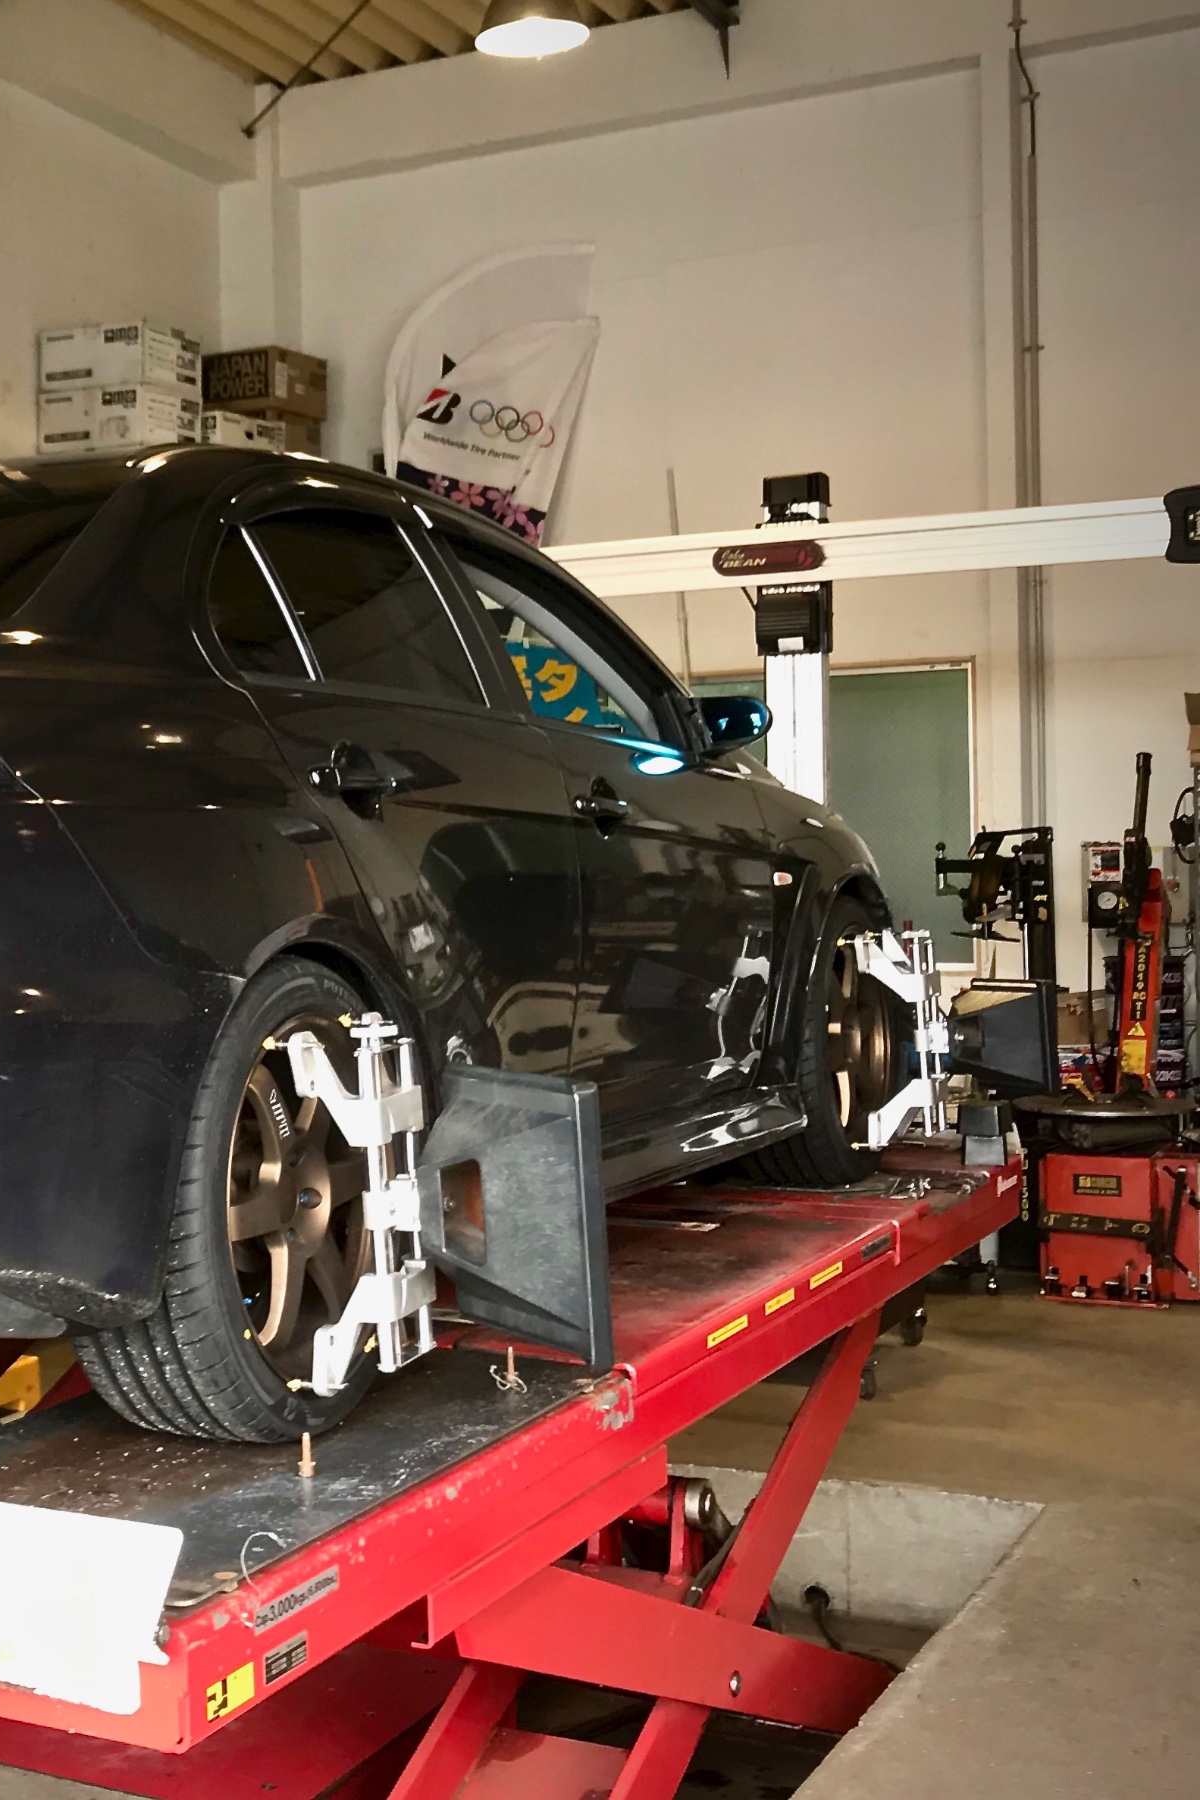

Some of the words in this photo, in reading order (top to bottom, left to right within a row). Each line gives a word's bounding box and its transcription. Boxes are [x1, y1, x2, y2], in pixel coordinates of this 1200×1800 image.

[209, 353, 266, 378] JAPAN
[209, 375, 266, 399] POWER
[423, 431, 469, 451] Worldwide
[470, 444, 487, 456] Tire
[720, 557, 767, 569] BEAN
